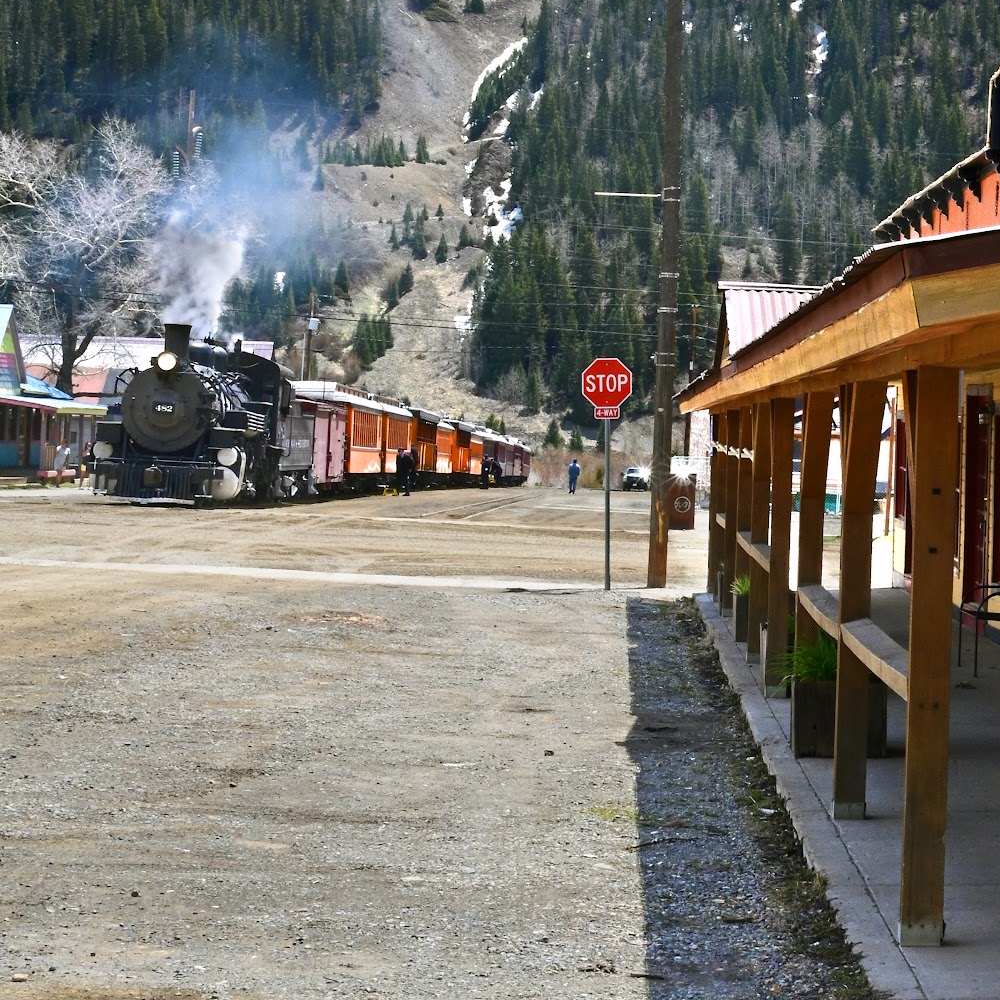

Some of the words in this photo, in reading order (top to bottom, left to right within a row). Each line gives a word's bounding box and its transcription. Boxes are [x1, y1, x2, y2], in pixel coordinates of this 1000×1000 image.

[586, 373, 628, 393] STOP
[154, 404, 173, 413] 482
[596, 408, 619, 417] 4-WAY
